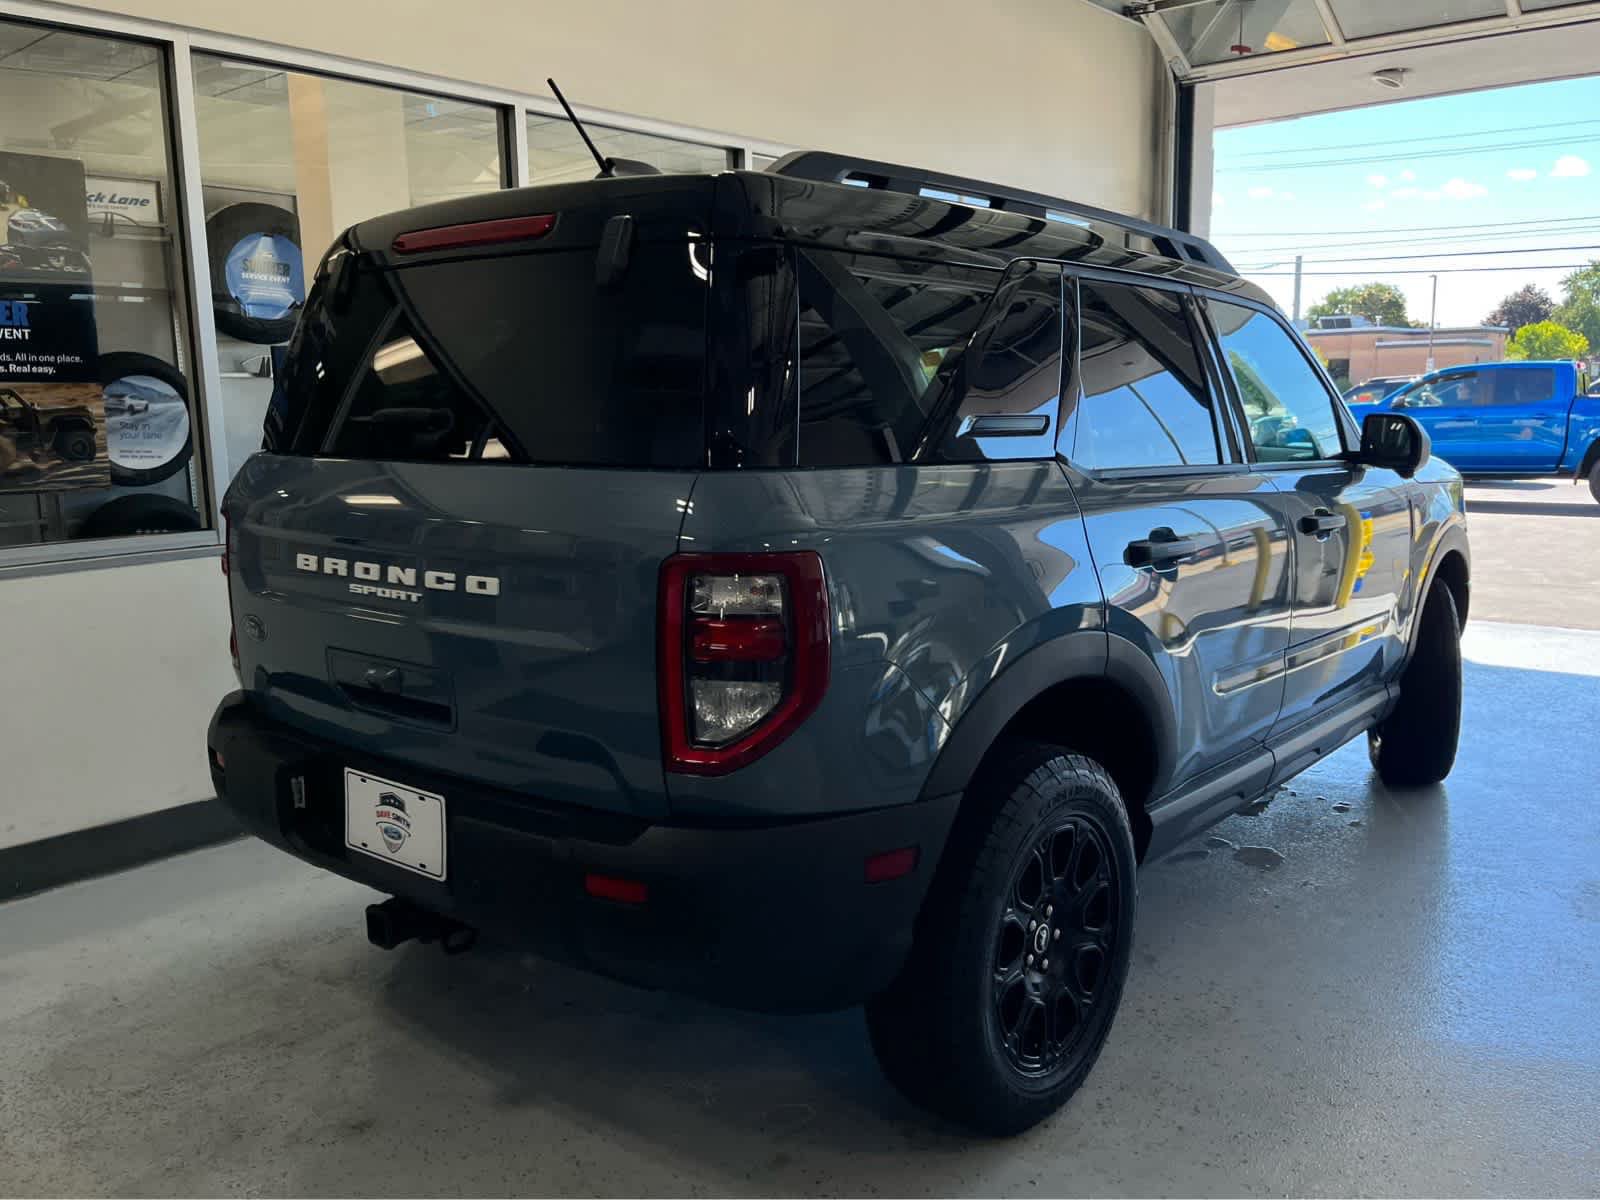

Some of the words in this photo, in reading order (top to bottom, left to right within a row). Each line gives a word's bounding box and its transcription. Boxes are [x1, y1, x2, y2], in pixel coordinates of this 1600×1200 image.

[108, 193, 150, 206] Lane
[0, 301, 29, 326] ER
[15, 352, 27, 361] All
[28, 353, 37, 361] in
[57, 354, 83, 365] place.
[9, 364, 31, 373] Real
[32, 365, 56, 375] easy.
[119, 421, 139, 432] Stay
[296, 553, 499, 596] BRONCO
[348, 583, 422, 603] SPORT
